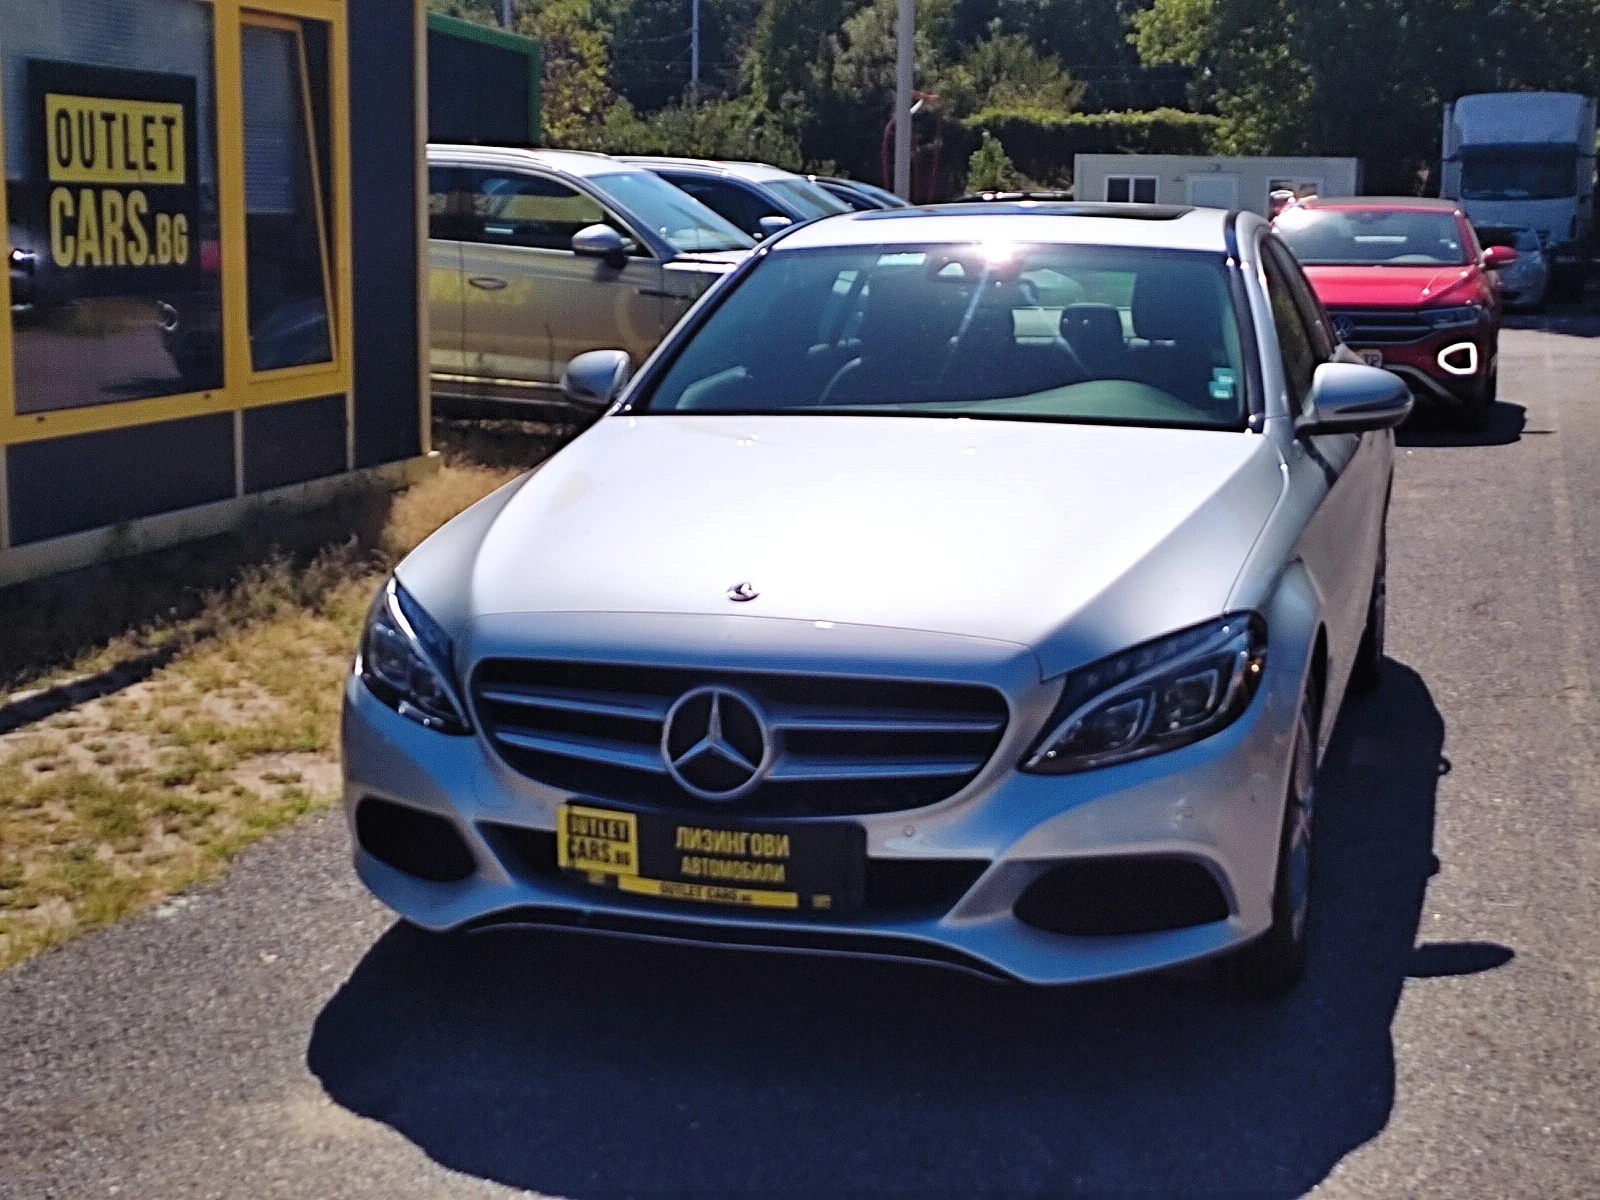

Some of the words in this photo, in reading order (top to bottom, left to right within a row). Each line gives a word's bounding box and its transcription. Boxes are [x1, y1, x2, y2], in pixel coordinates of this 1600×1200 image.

[54, 107, 177, 173] OUTLET
[50, 186, 189, 267] CARS.BG
[567, 813, 629, 843] OUTLET
[675, 826, 790, 857] ЛИЗИНГОВИ
